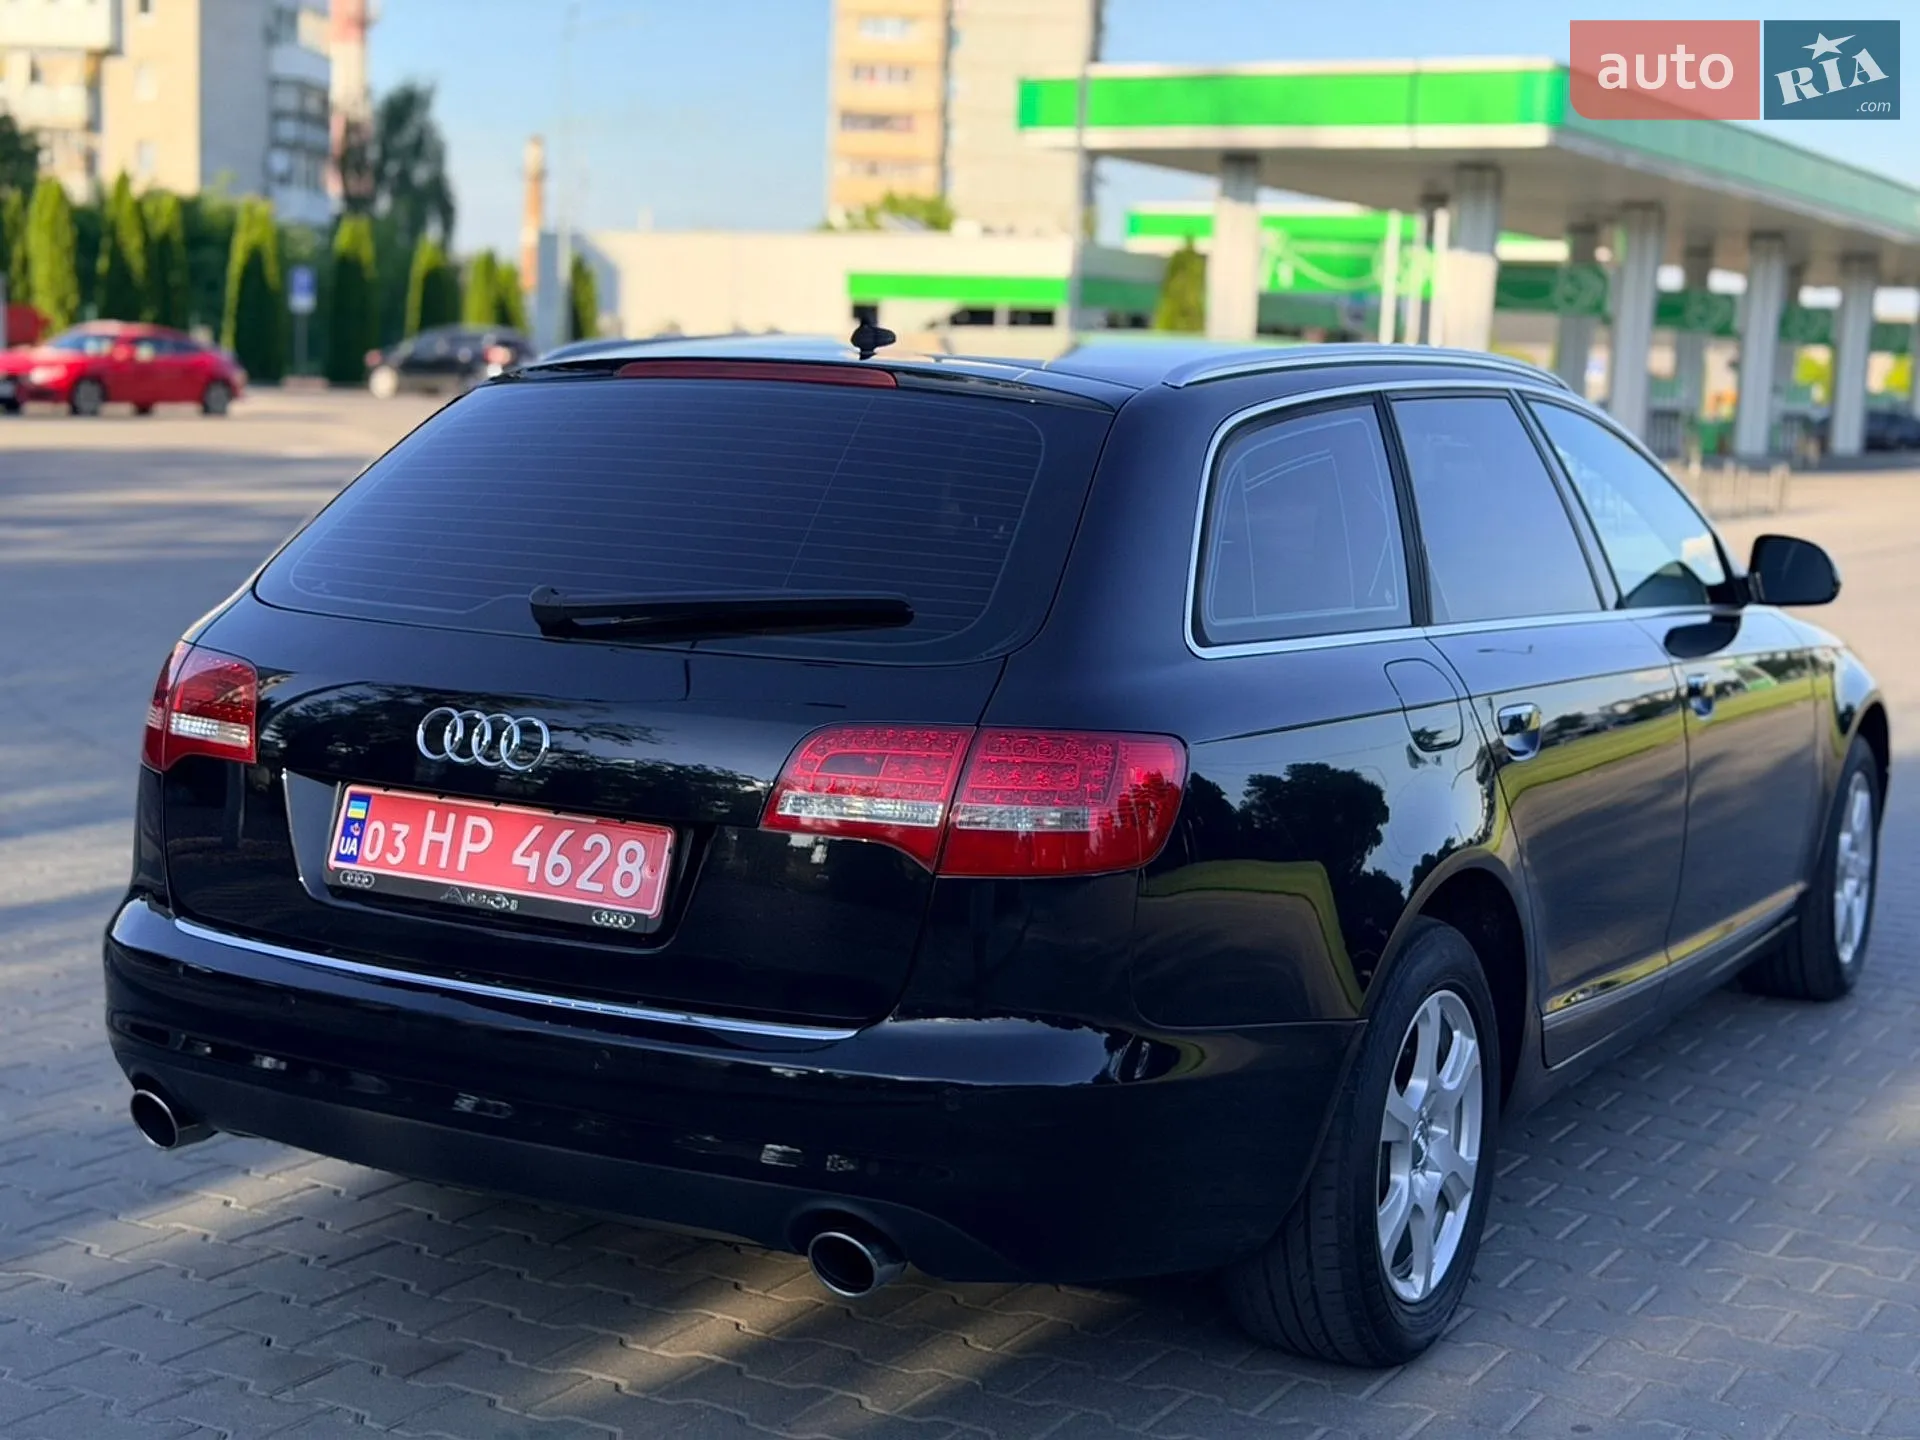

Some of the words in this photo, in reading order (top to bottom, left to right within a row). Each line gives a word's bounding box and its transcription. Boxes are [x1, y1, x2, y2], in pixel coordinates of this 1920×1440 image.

[339, 836, 358, 857] UA
[362, 819, 410, 866] 03
[417, 809, 494, 872] HP
[511, 824, 646, 898] 4628
